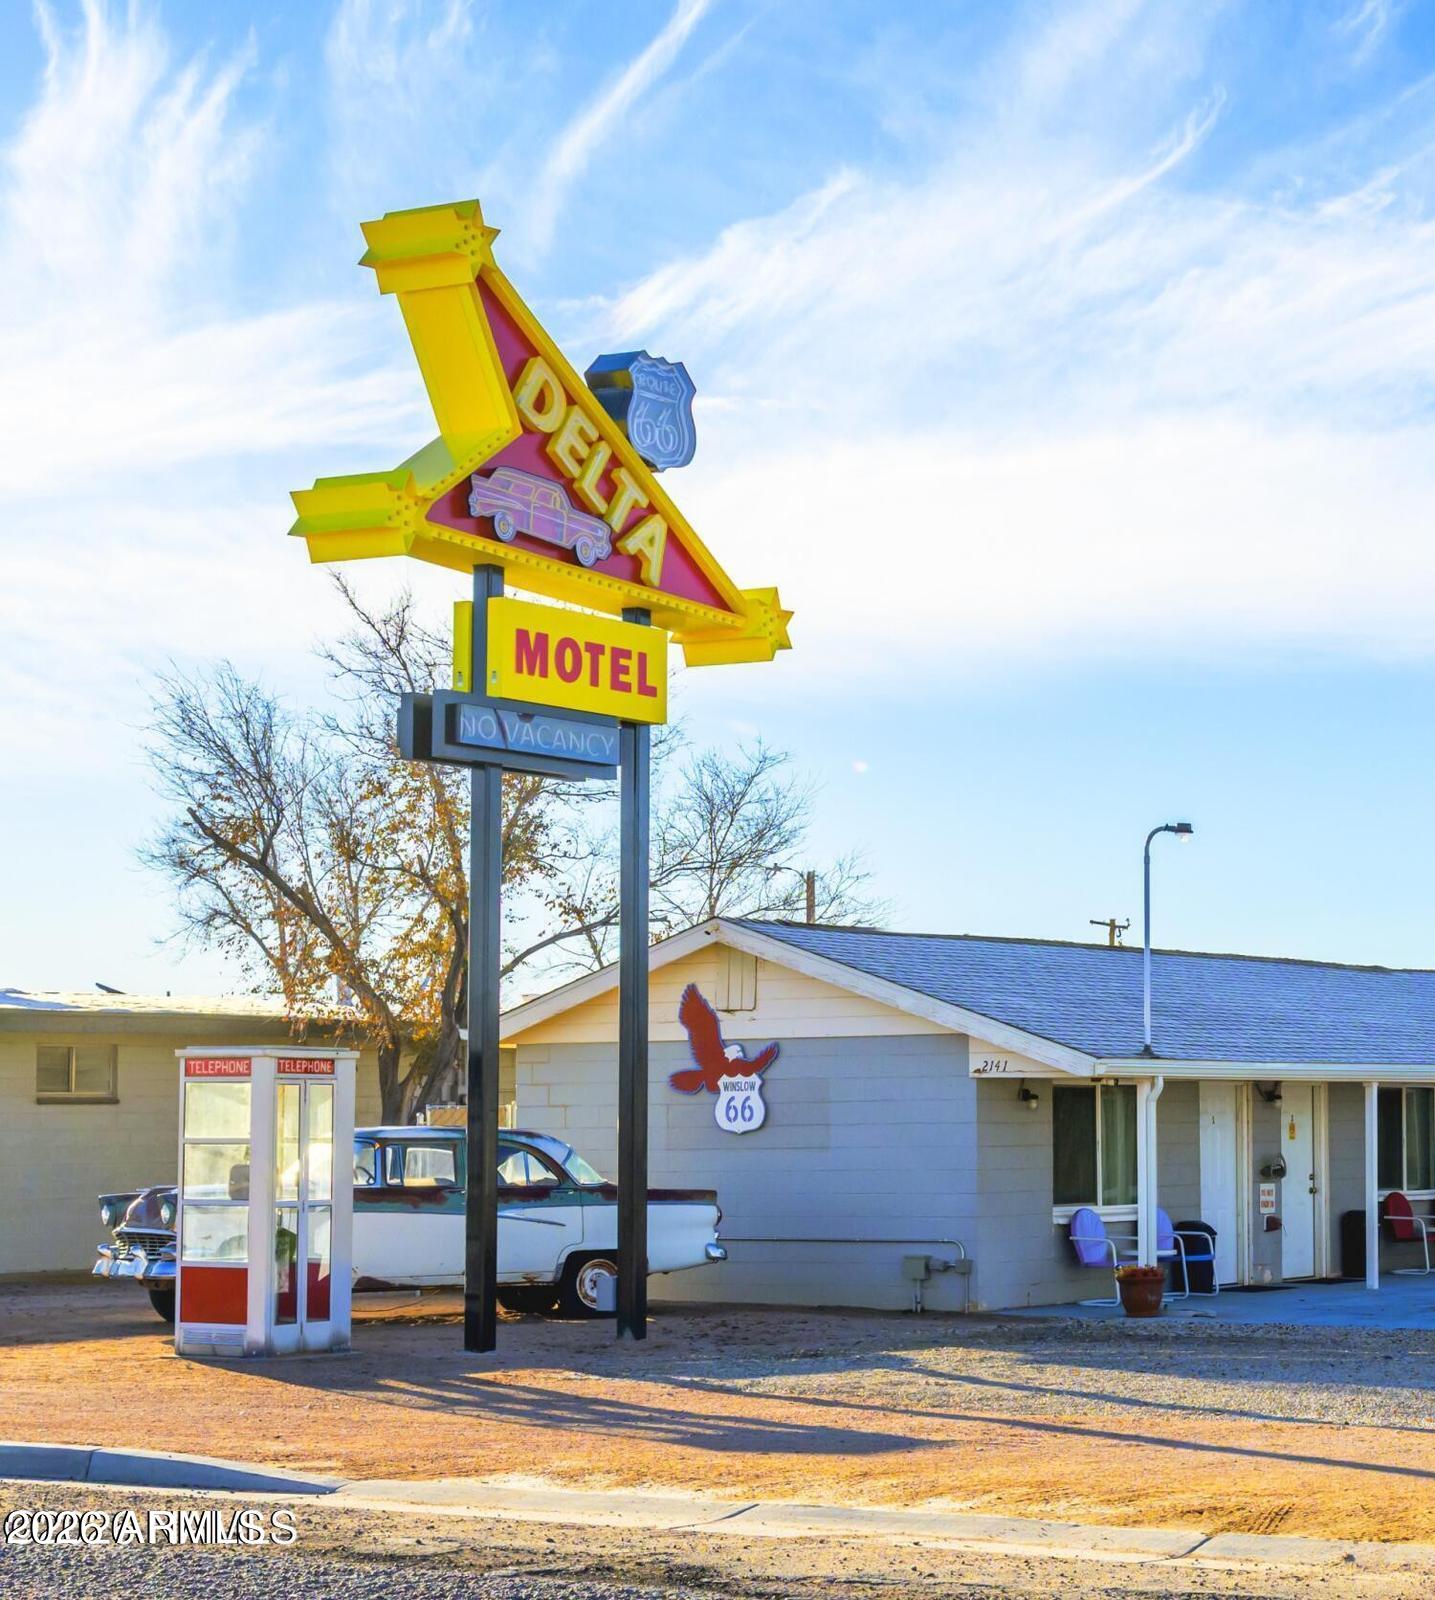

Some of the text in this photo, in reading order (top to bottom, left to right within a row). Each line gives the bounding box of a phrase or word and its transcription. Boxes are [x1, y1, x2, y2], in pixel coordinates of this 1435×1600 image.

[634, 401, 679, 453] 66
[513, 355, 668, 588] DELTA
[514, 628, 658, 698] MOTEL
[460, 716, 614, 757] NO VACANCY
[189, 1060, 250, 1073] TELEPHONE
[278, 1060, 333, 1073] TELEPHONE
[981, 1060, 1008, 1072] 2141
[722, 1081, 756, 1092] WINSLOW
[725, 1095, 754, 1123] 66
